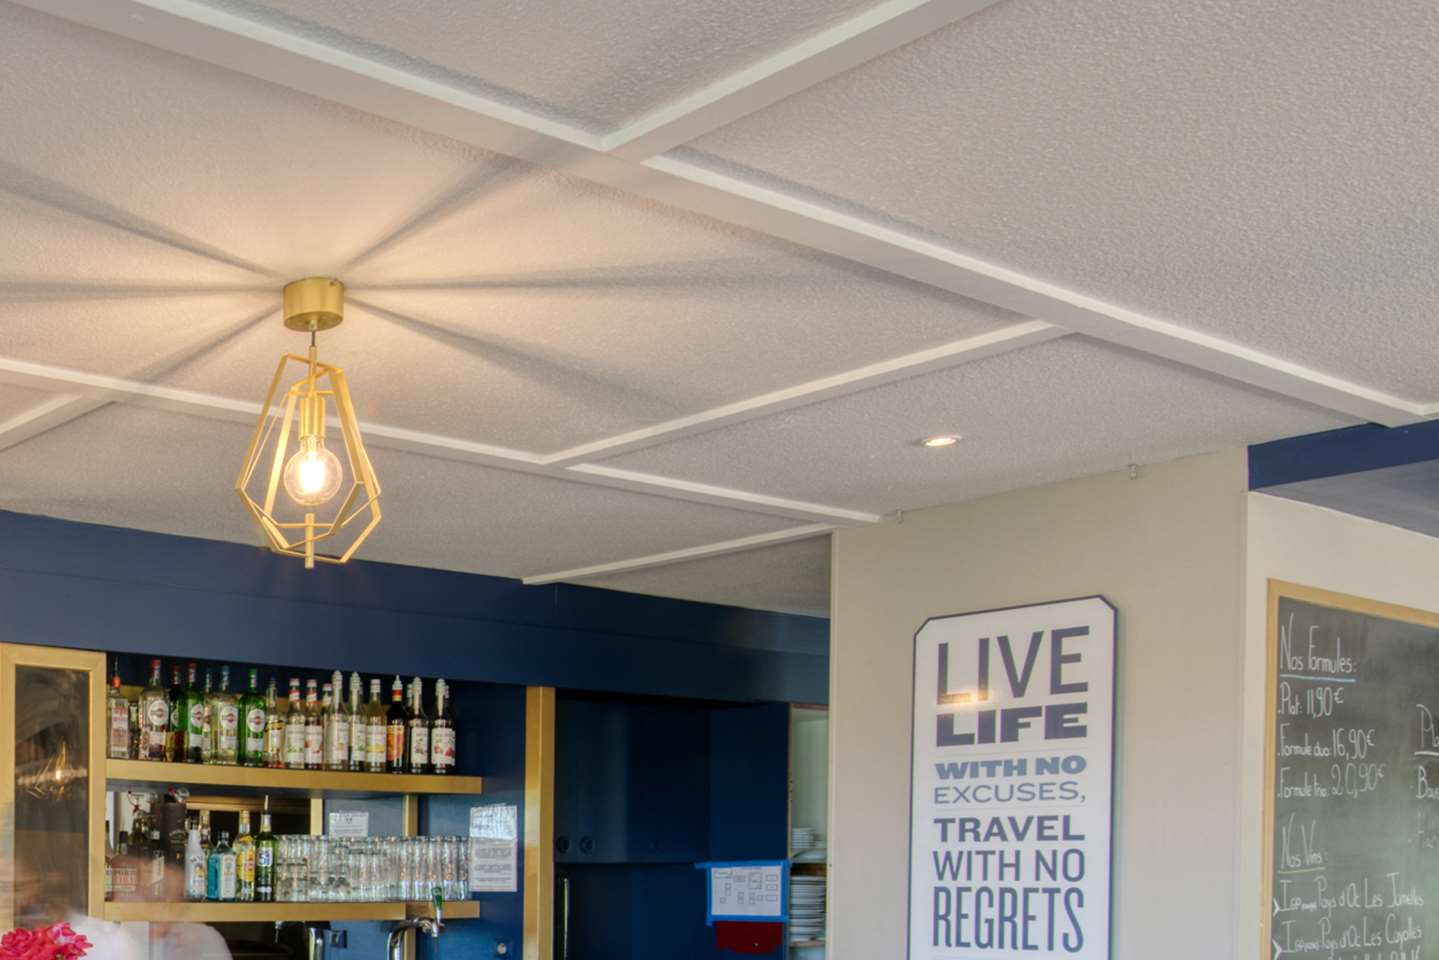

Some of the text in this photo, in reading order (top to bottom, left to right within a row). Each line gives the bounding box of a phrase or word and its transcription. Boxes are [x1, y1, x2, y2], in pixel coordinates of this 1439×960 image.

[1279, 611, 1304, 671] Nos
[936, 625, 1090, 705] LIVE
[936, 702, 1088, 747] LIFE
[935, 755, 1087, 780] WITH NO
[934, 780, 1086, 804] EXCUSES,
[934, 815, 1085, 842] TRAVEL
[1280, 811, 1302, 870] Nos
[933, 848, 1085, 882] WITH NO
[932, 886, 1085, 953] REGRETS
